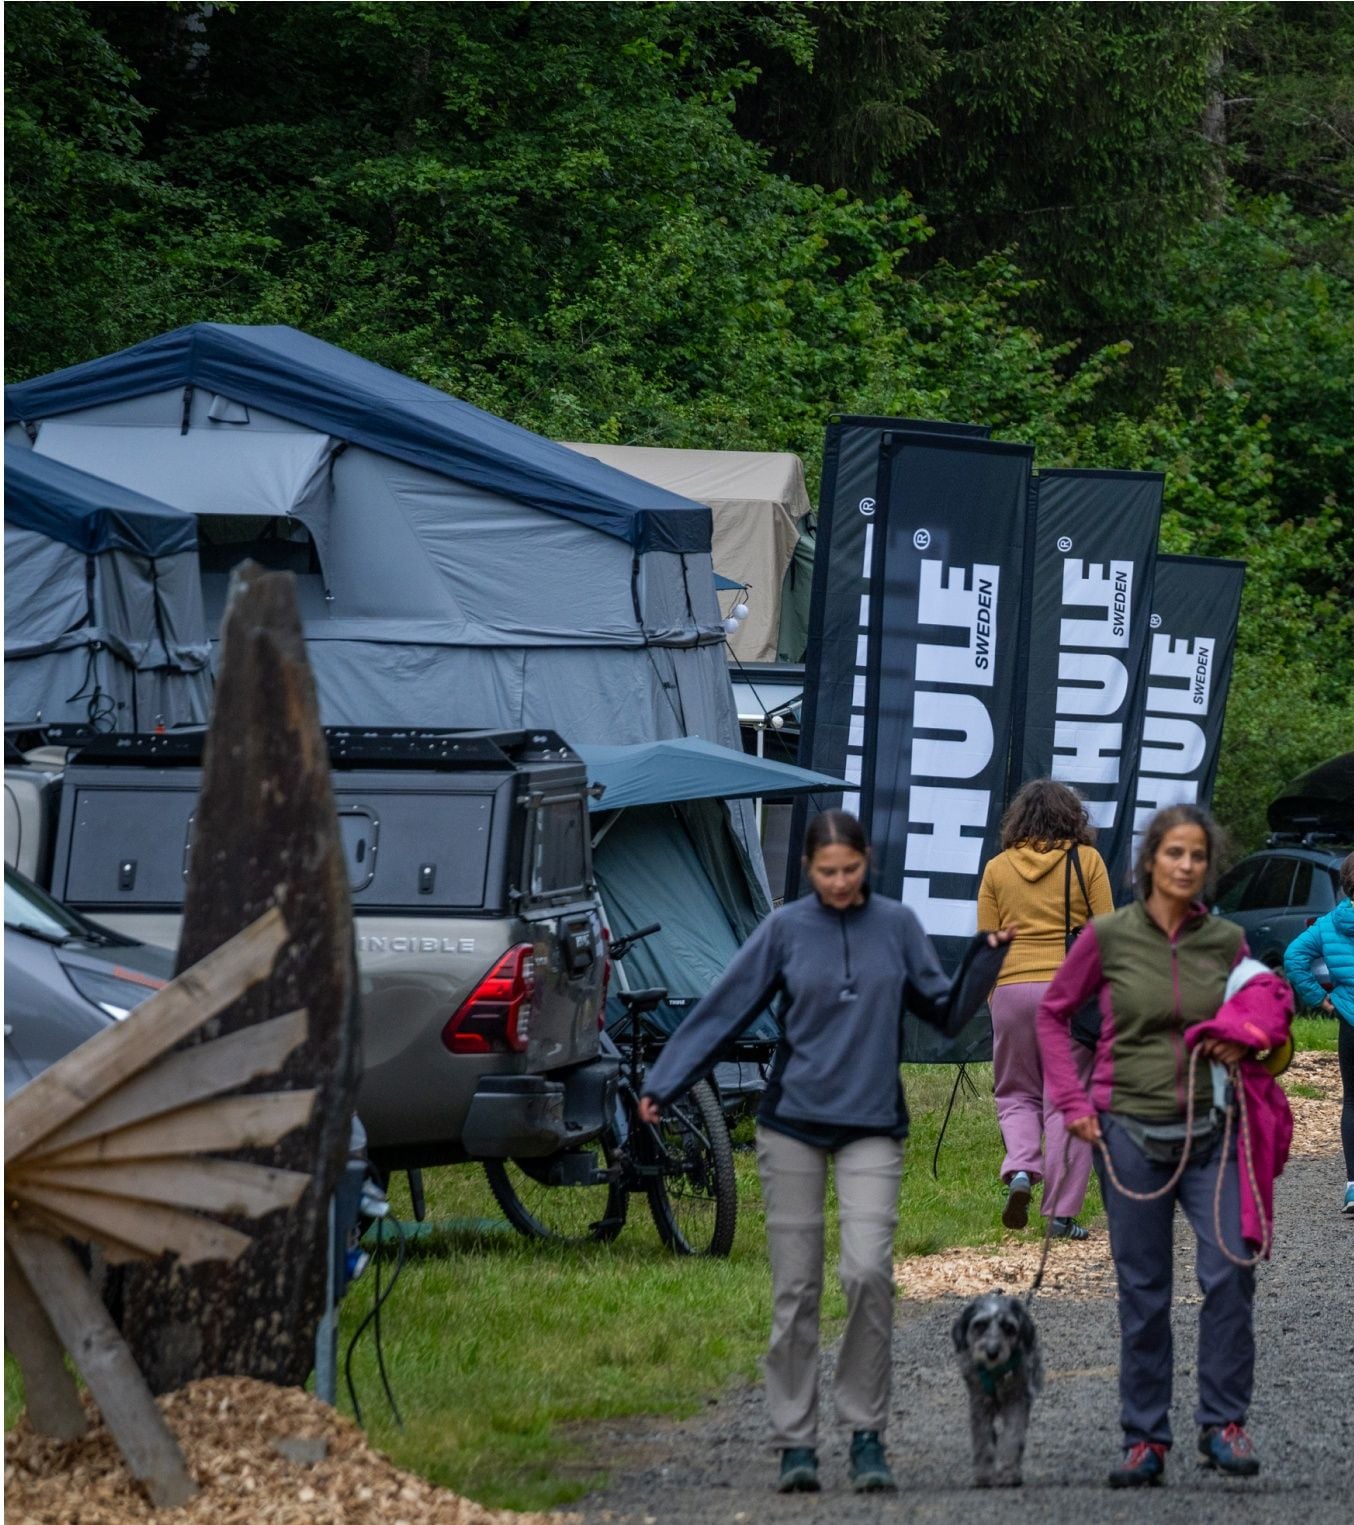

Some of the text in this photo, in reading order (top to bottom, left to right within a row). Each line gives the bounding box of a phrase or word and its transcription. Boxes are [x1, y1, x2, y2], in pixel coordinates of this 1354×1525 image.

[975, 579, 993, 670] SWEDEN
[1113, 570, 1129, 637] SWEDEN
[1193, 647, 1209, 705] SWEDEN
